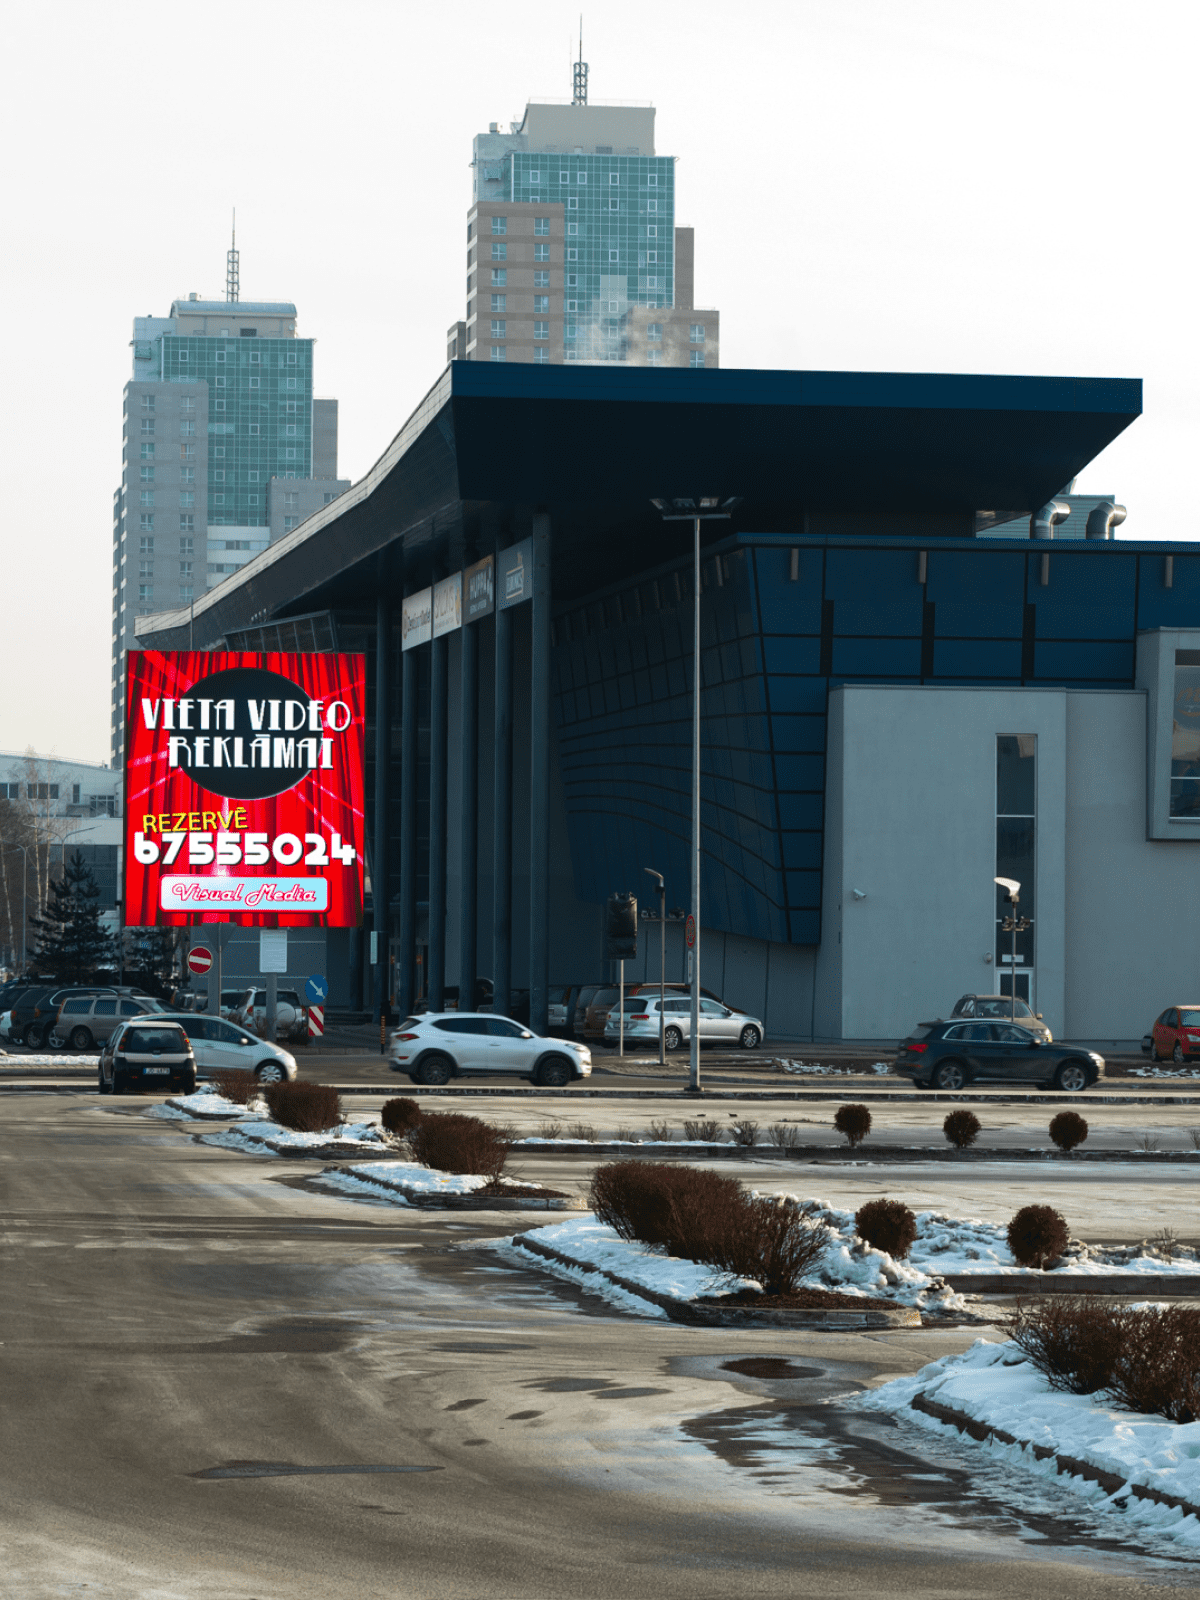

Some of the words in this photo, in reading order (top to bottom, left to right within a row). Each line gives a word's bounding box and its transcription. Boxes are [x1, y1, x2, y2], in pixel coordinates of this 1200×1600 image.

[141, 698, 235, 730] VIETA
[247, 699, 352, 732] VIDEO
[166, 733, 334, 769] REKLĀMAI
[142, 806, 248, 833] REZERVĒ
[134, 831, 357, 866] 67555024
[171, 883, 245, 901] Visual
[244, 883, 317, 907] Media
